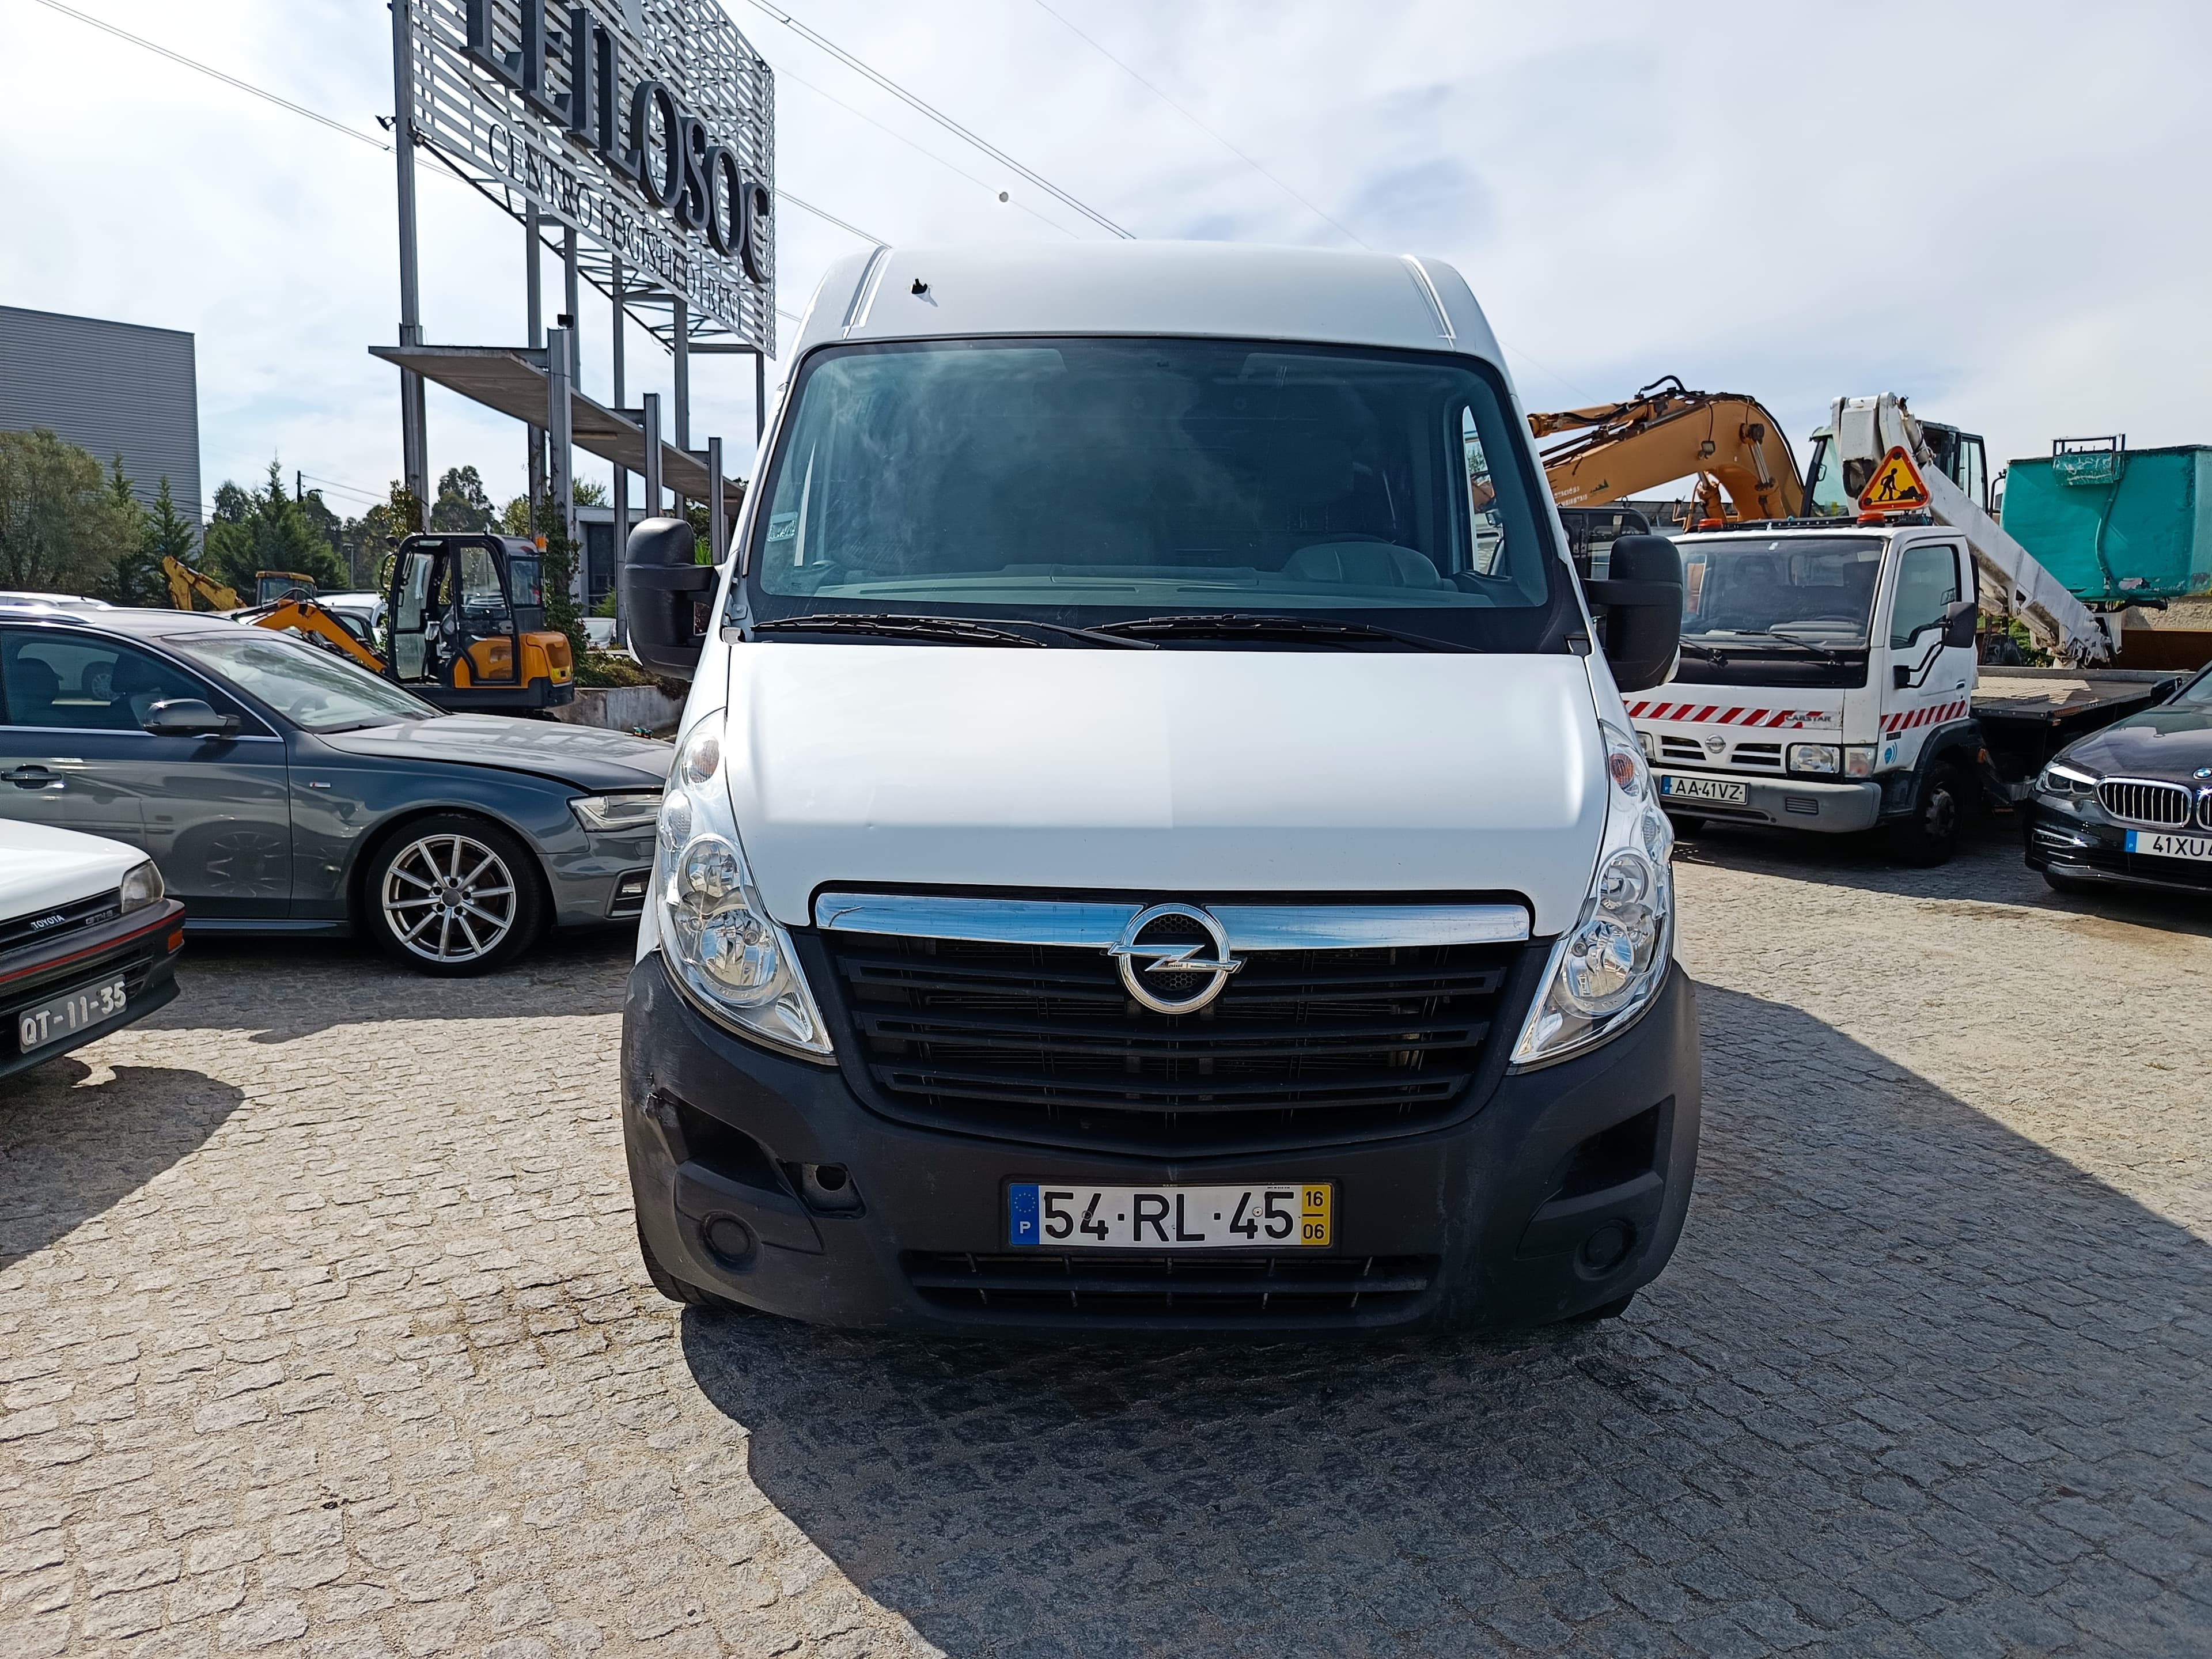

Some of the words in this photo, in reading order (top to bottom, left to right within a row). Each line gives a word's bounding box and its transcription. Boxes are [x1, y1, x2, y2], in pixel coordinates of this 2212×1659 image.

[489, 123, 592, 228] CENTRO
[31, 915, 65, 930] TOYOTA
[21, 981, 126, 1046] QT-11-35
[1305, 1191, 1324, 1207] 16
[1020, 1221, 1031, 1234] P
[1303, 1224, 1324, 1239] 06
